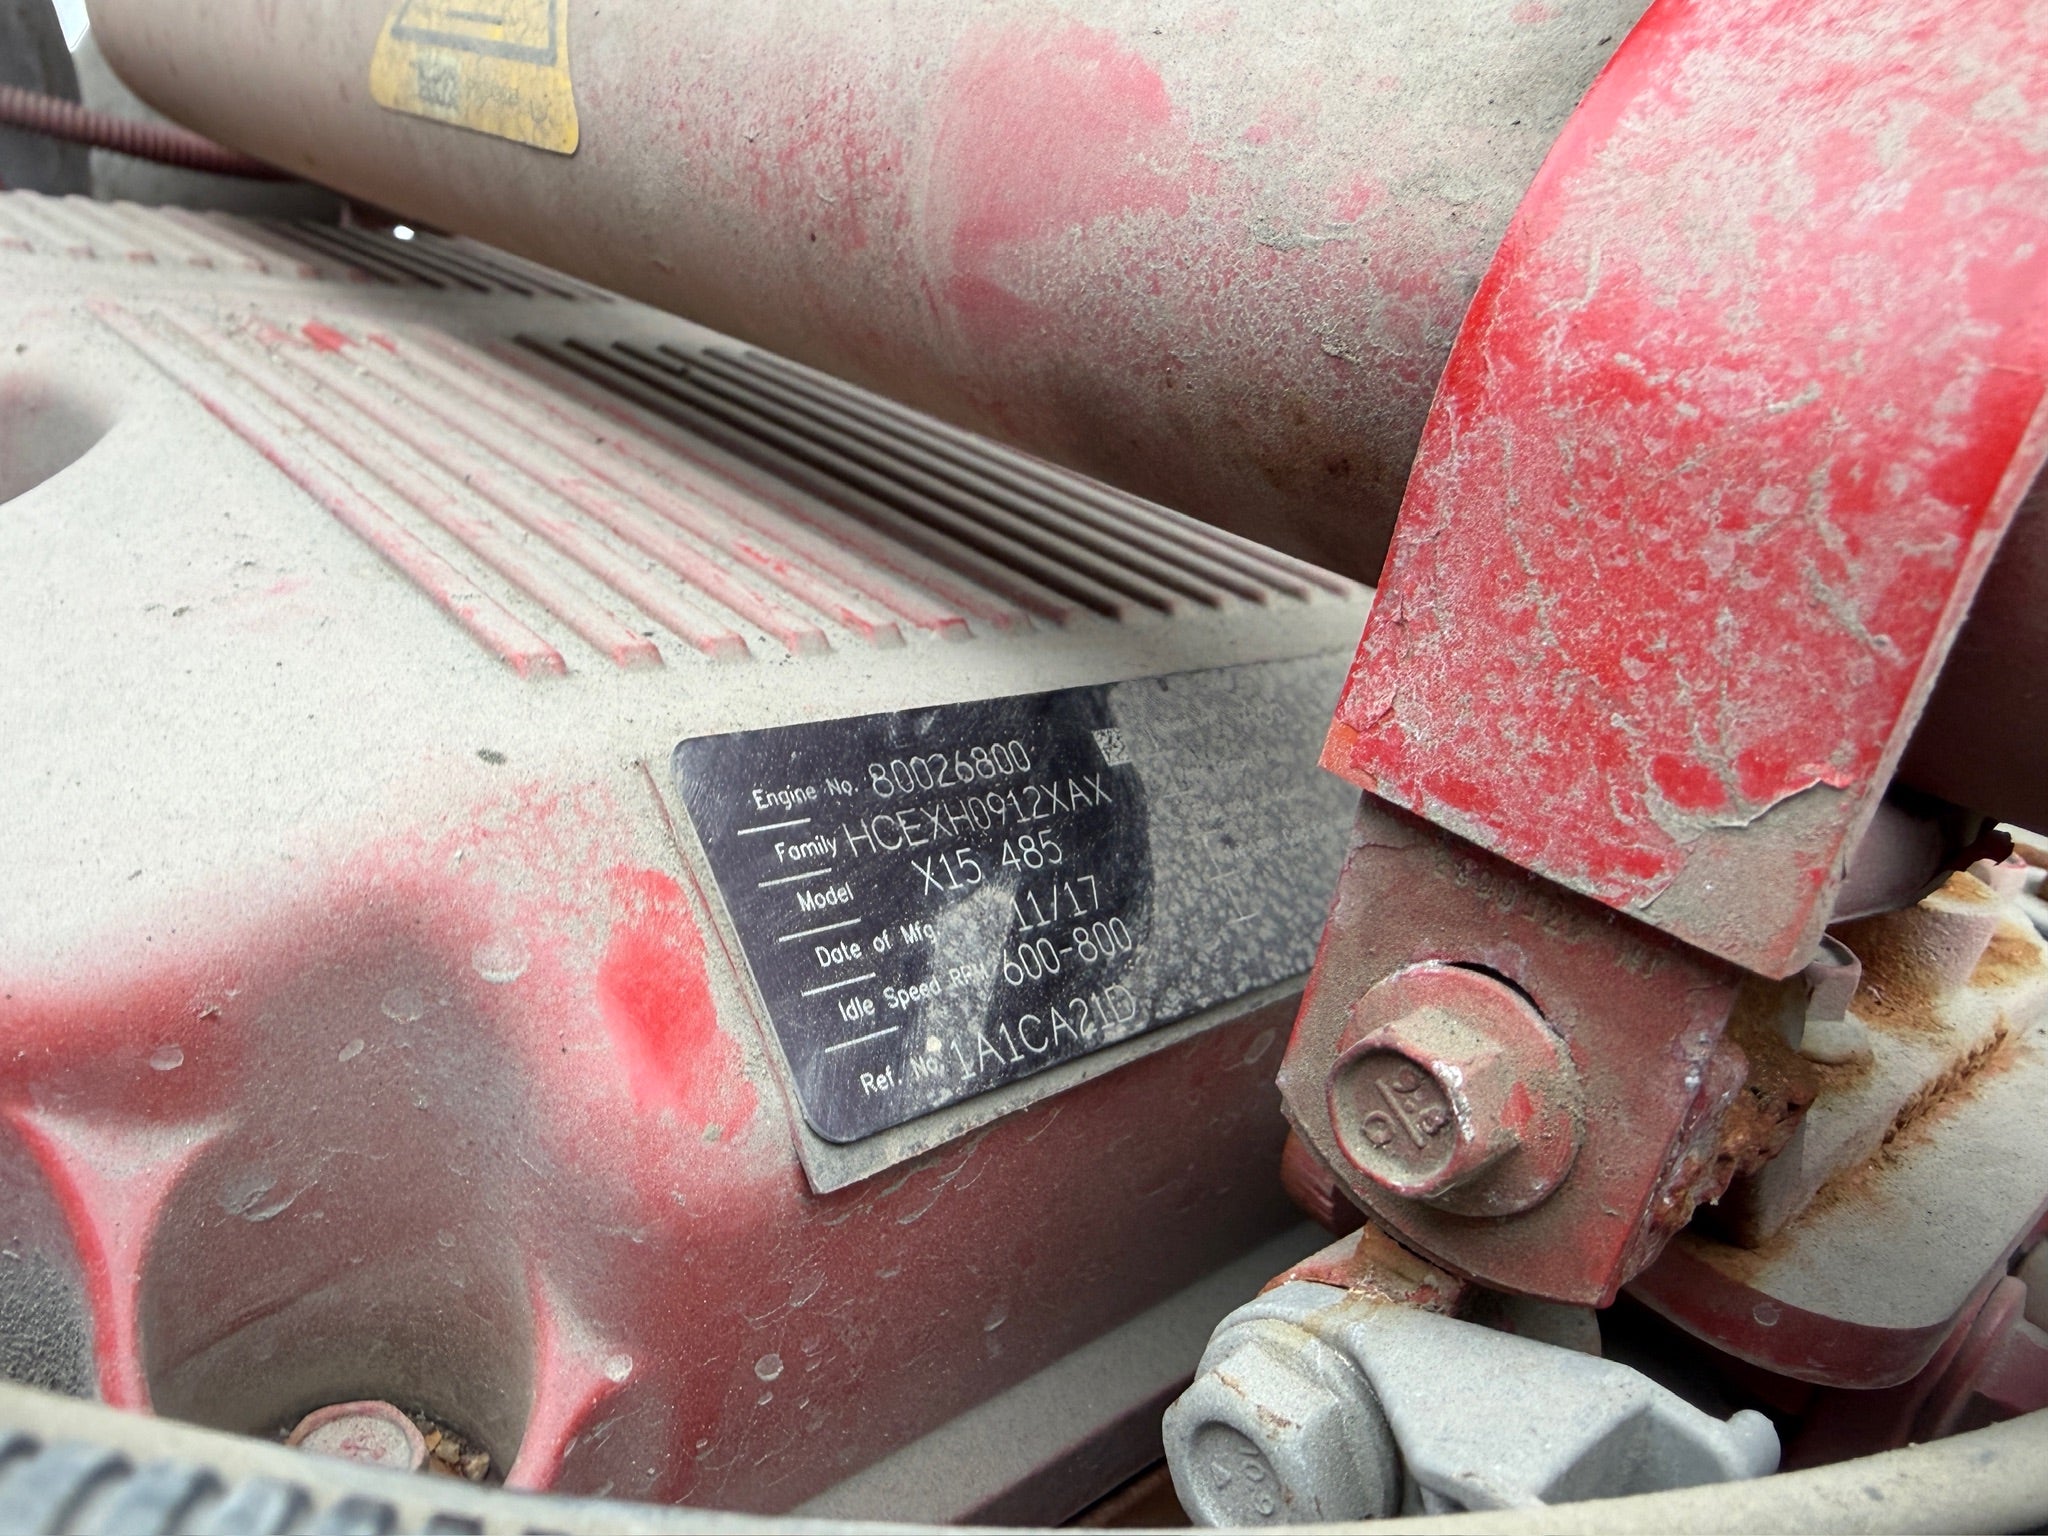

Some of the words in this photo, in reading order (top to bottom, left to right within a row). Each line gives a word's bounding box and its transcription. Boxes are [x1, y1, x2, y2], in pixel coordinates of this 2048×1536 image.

[751, 784, 818, 811] Engine
[825, 777, 859, 797] No.
[868, 740, 1031, 798] 80026800
[774, 834, 838, 863] Family
[841, 772, 1113, 858] HCEXH0912XAX
[796, 882, 855, 912] Model
[911, 847, 982, 896] X15
[1001, 828, 1063, 872] 485
[814, 940, 863, 968] Date
[872, 928, 893, 954] of
[1011, 874, 1099, 932] 11/17
[838, 995, 876, 1022] Idle
[882, 975, 942, 1011] Speed
[1003, 916, 1132, 986] 600-800
[860, 1064, 903, 1096] Ref.
[950, 983, 1137, 1081] 1A1CA21D
